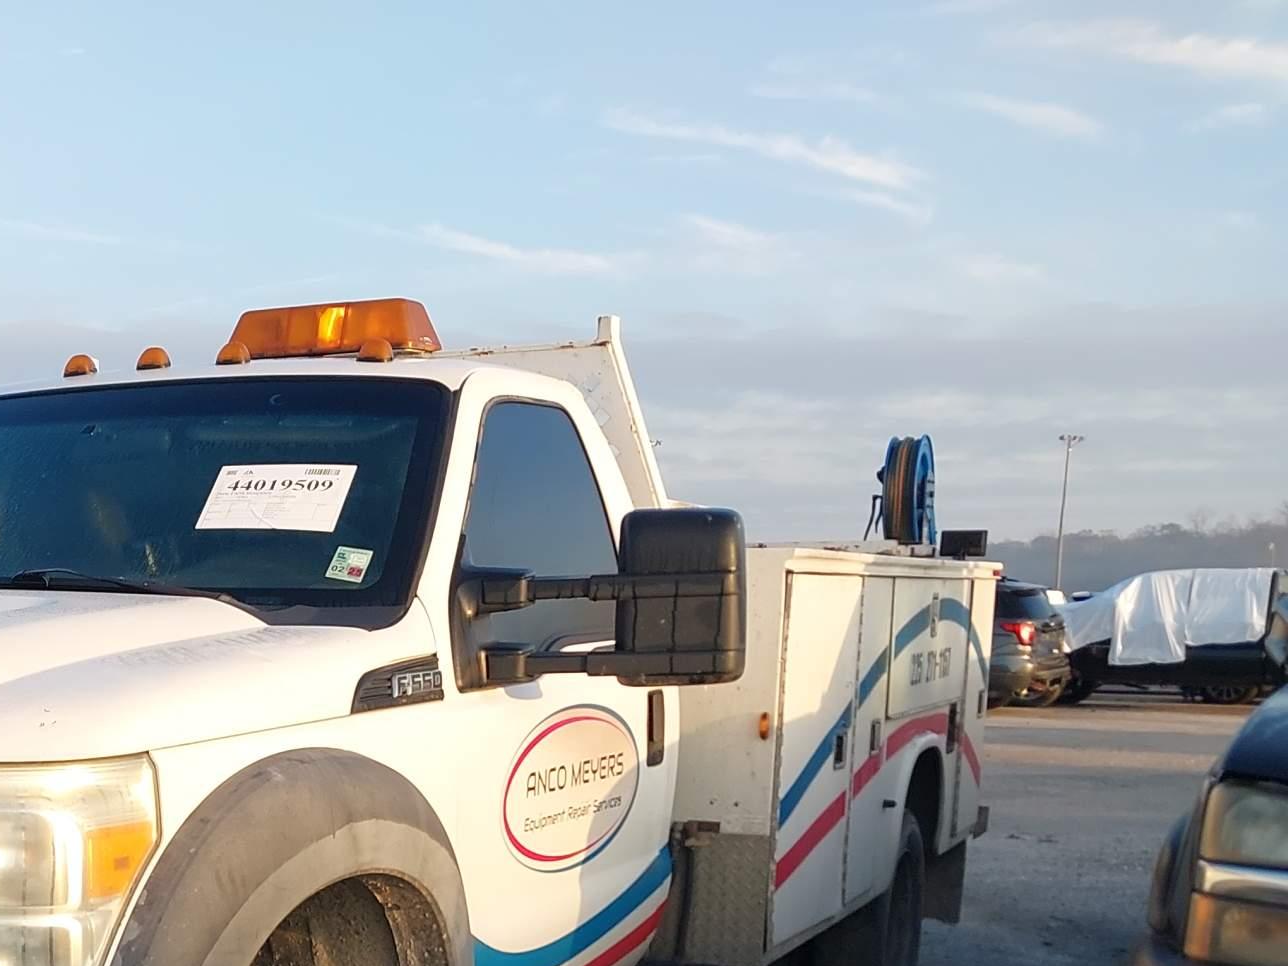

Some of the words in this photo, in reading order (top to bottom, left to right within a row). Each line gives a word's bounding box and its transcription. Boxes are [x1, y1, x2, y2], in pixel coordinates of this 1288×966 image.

[227, 479, 334, 491] 44019509
[526, 765, 567, 798] ANCO
[571, 752, 624, 787] MEYERS
[523, 810, 566, 833] Equipment
[568, 803, 591, 820] Repair
[593, 795, 622, 813] Services
